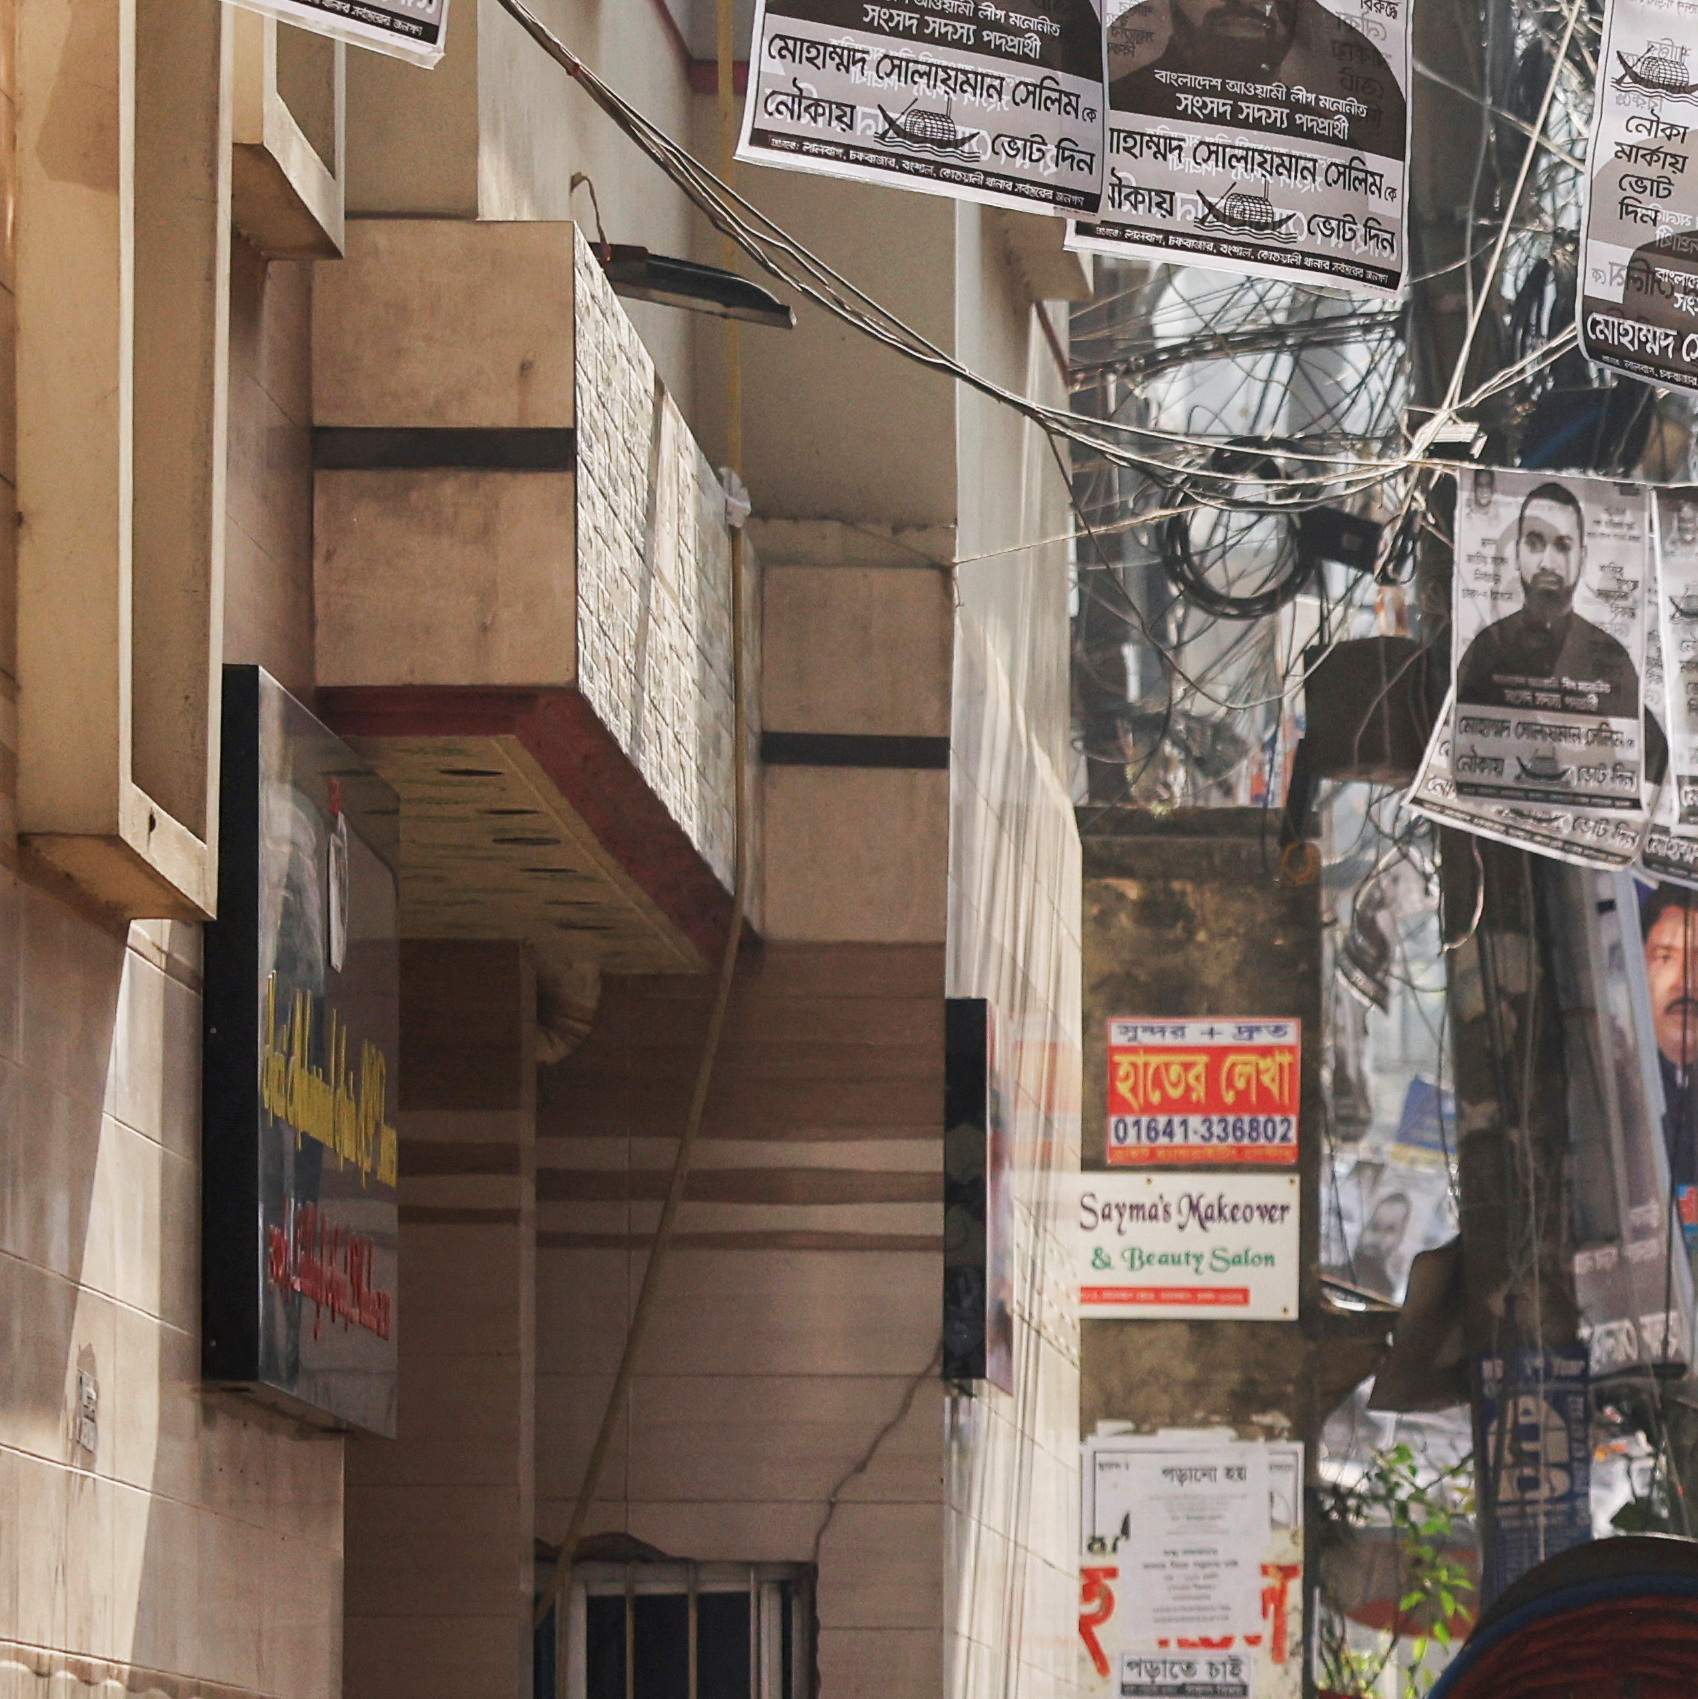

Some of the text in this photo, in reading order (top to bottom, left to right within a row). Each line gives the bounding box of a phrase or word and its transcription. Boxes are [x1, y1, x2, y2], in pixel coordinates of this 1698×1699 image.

[863, 4, 918, 35] সংসদ
[924, 14, 975, 45] সদস্য
[982, 28, 1042, 61] পদপ্রার্থী
[1009, 13, 1060, 38] মনোনীত
[767, 33, 1098, 123] মোহাম্মদ সোলায়মান সেলিম কে
[1154, 68, 1368, 119] বাংলাদেশ আওয়ামী লীগ মনোনীত
[764, 77, 1096, 176] নৌকায় ভোট দিন
[1175, 92, 1349, 141] সংসদ সদস্য পদপ্রার্থী
[1625, 109, 1689, 144] নৌকা
[1109, 127, 1397, 203] োহাম্মদ সোলায়মান সেলিম কে
[1614, 141, 1688, 174] মার্কায়
[1618, 173, 1674, 200] ভোট
[1307, 214, 1357, 242] ভোট
[1363, 216, 1396, 254] দিন
[1619, 196, 1660, 227] দিন
[1586, 312, 1678, 358] মোহাম্মদ
[1113, 1049, 1294, 1112] হাতের লেখা
[1080, 1191, 1291, 1236] Sayma's Makeover
[1091, 1246, 1275, 1274] & Beauty Salon
[1126, 1654, 1244, 1681] পড়াতে চাই
